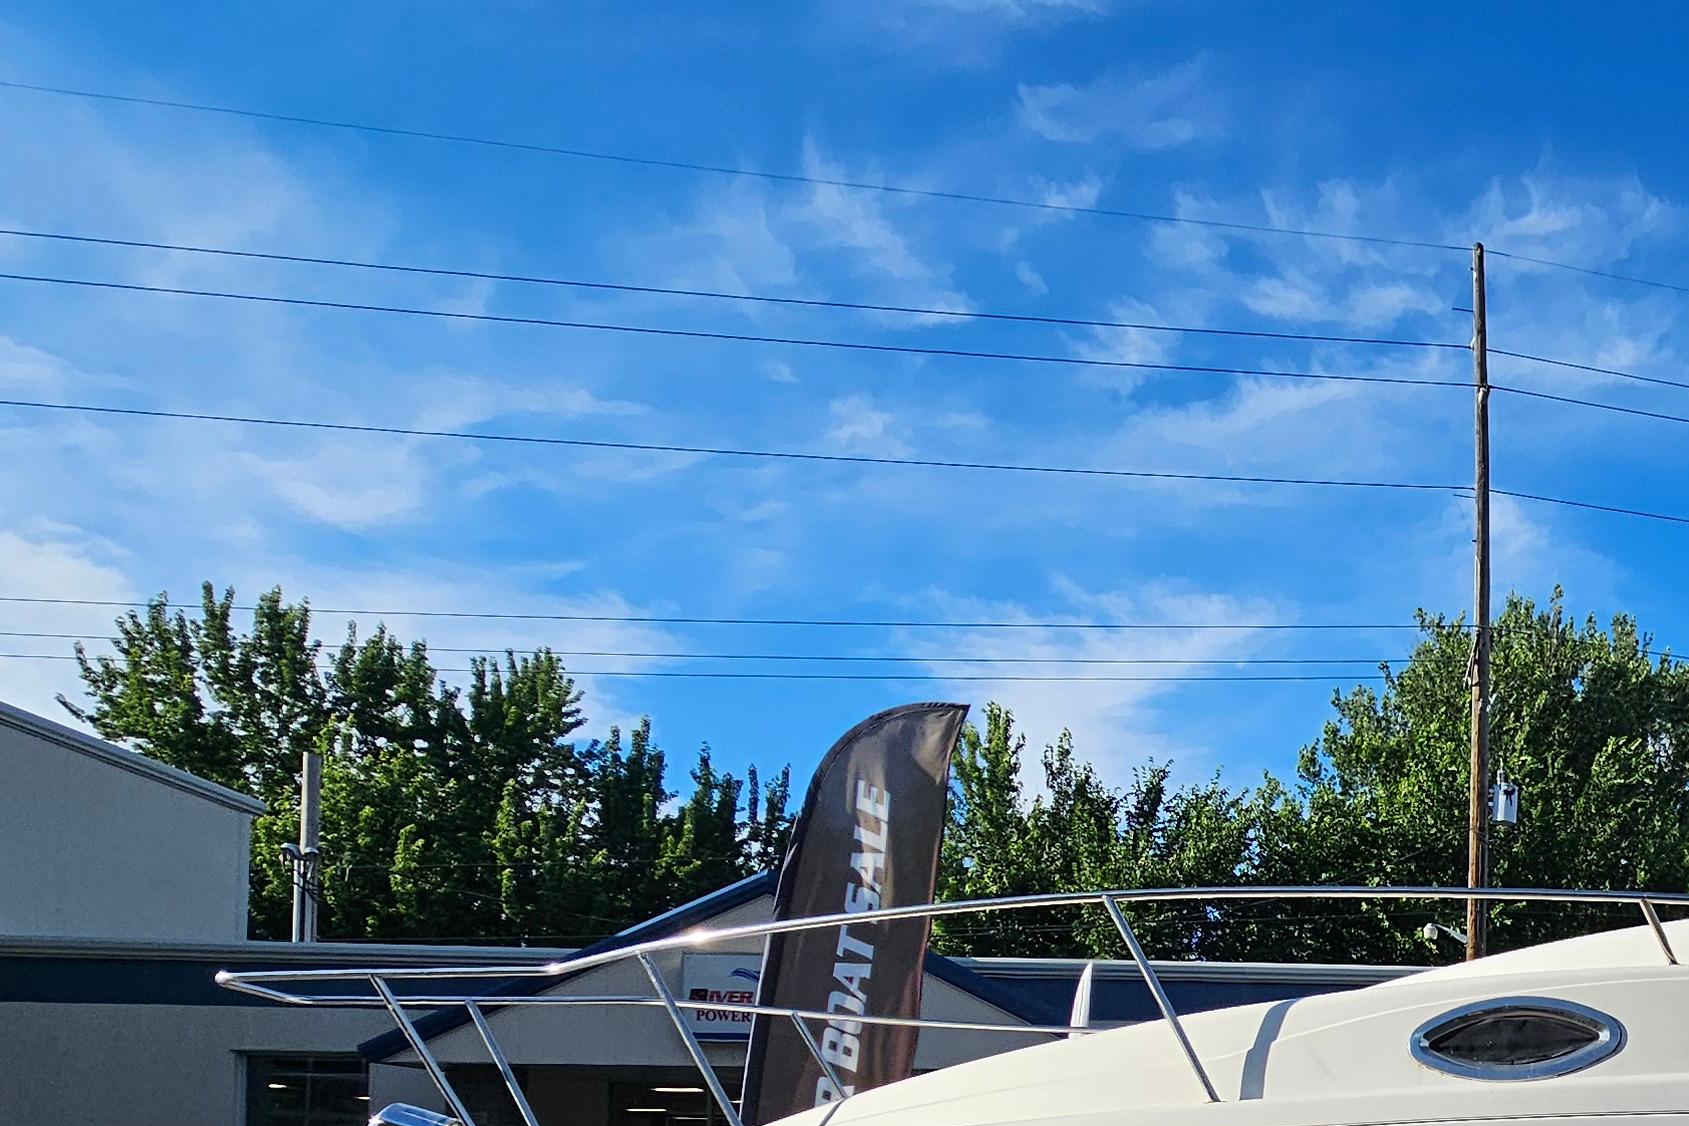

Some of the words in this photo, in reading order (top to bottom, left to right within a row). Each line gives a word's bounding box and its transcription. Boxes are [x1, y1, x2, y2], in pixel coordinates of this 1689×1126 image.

[844, 779, 891, 924] SALE
[696, 1009, 752, 1022] POWER
[821, 924, 874, 1073] BOAT
